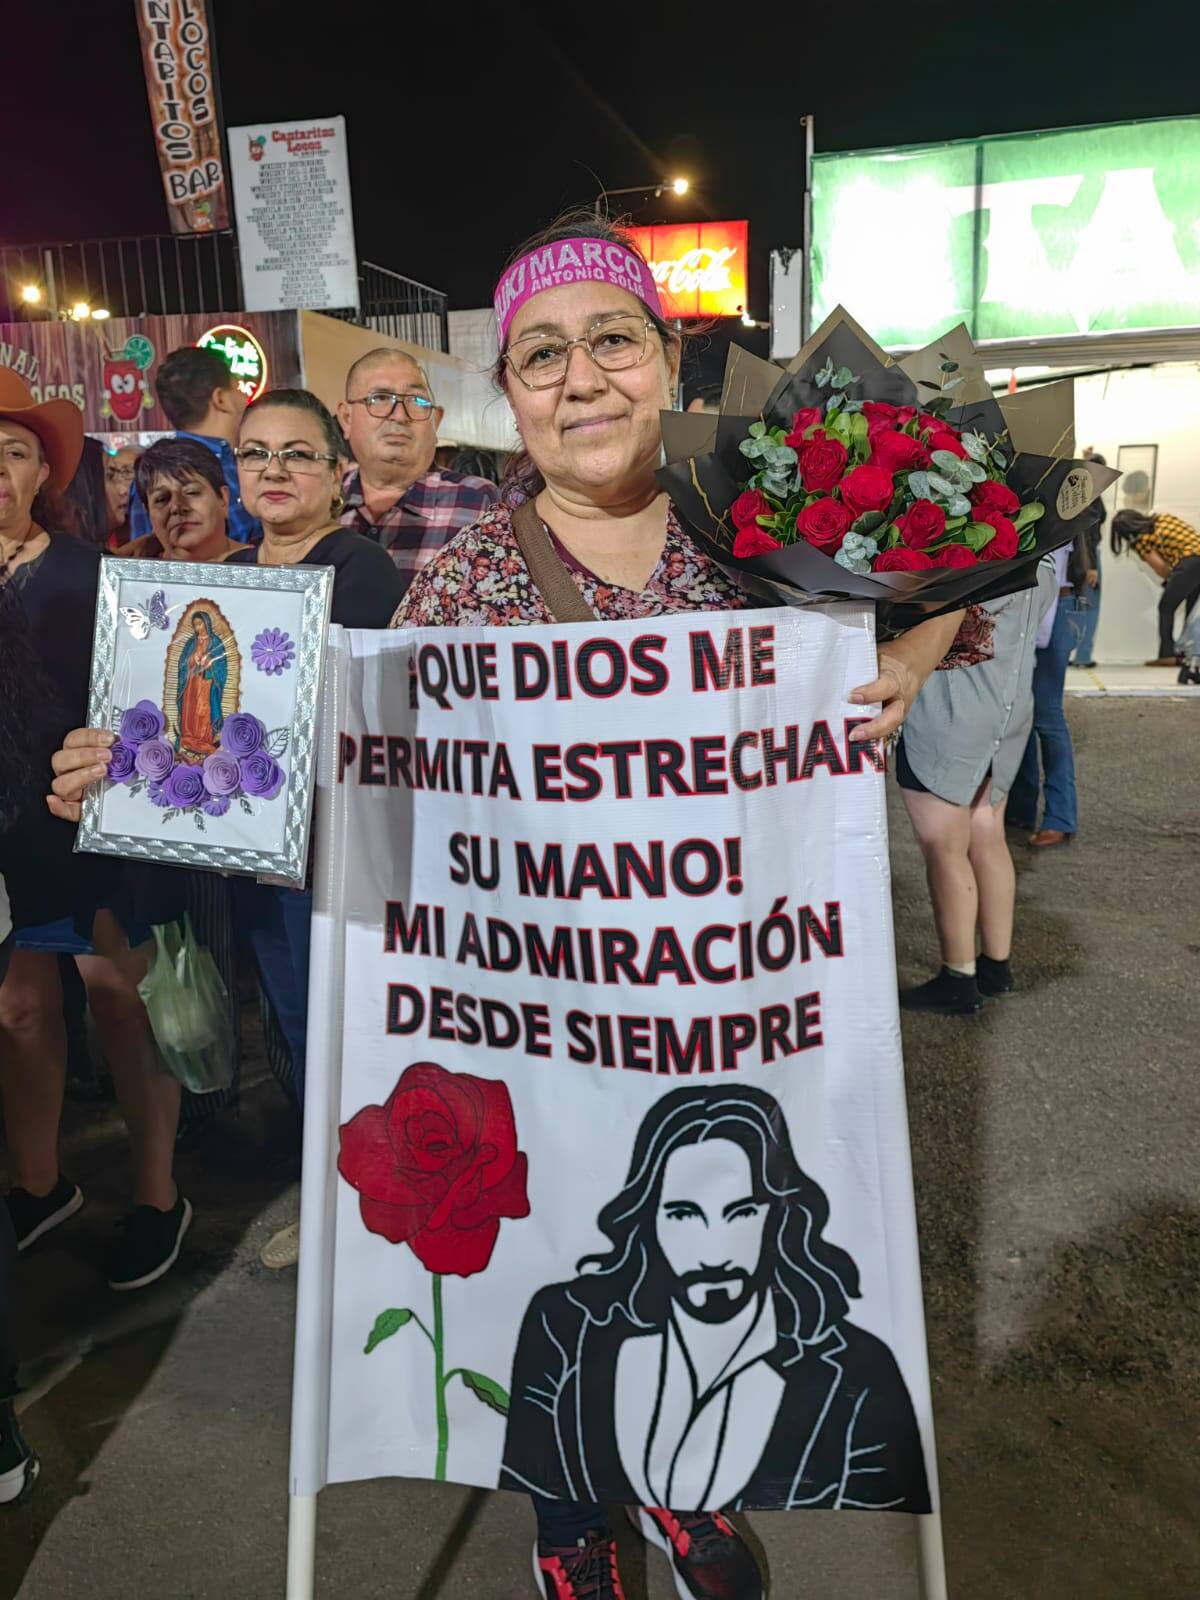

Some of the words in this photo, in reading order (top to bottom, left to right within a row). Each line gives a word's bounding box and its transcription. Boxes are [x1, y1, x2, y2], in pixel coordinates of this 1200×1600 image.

[168, 162, 221, 200] BAR
[530, 243, 642, 283] MARCO
[608, 271, 645, 298] SOLIS
[513, 635, 669, 702] DIOS
[688, 625, 776, 692] ME
[337, 731, 521, 801] PERMITA
[532, 716, 888, 802] ESTRECHAR
[449, 832, 500, 890] SU
[514, 836, 744, 900] MANO!
[384, 901, 446, 958] MI
[456, 896, 844, 986] ADMIRACIÓN
[386, 982, 552, 1058] DESDE
[566, 991, 823, 1075] SIEMPRE
